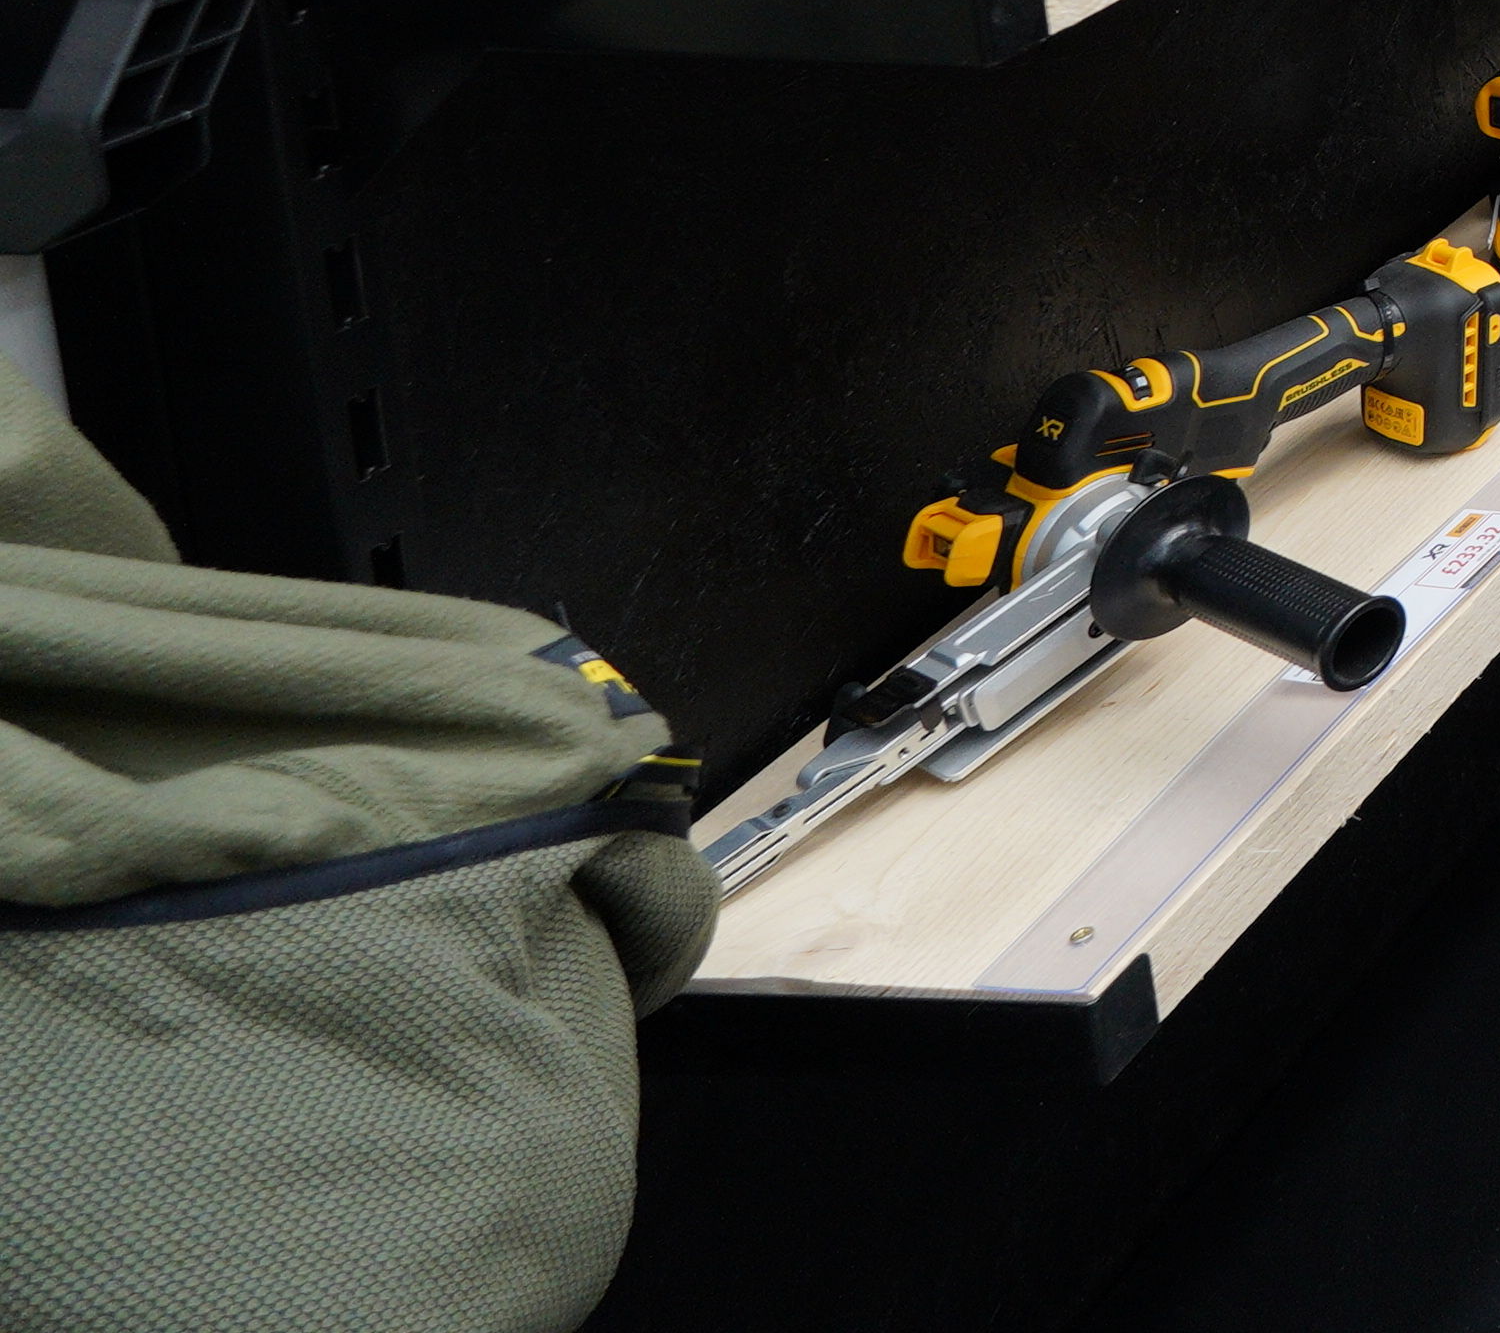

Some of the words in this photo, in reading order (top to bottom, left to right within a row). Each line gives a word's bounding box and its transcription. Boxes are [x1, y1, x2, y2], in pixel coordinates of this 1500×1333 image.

[1285, 361, 1354, 402] BRUSHLESS
[1035, 415, 1065, 441] XR
[1424, 543, 1451, 561] XR
